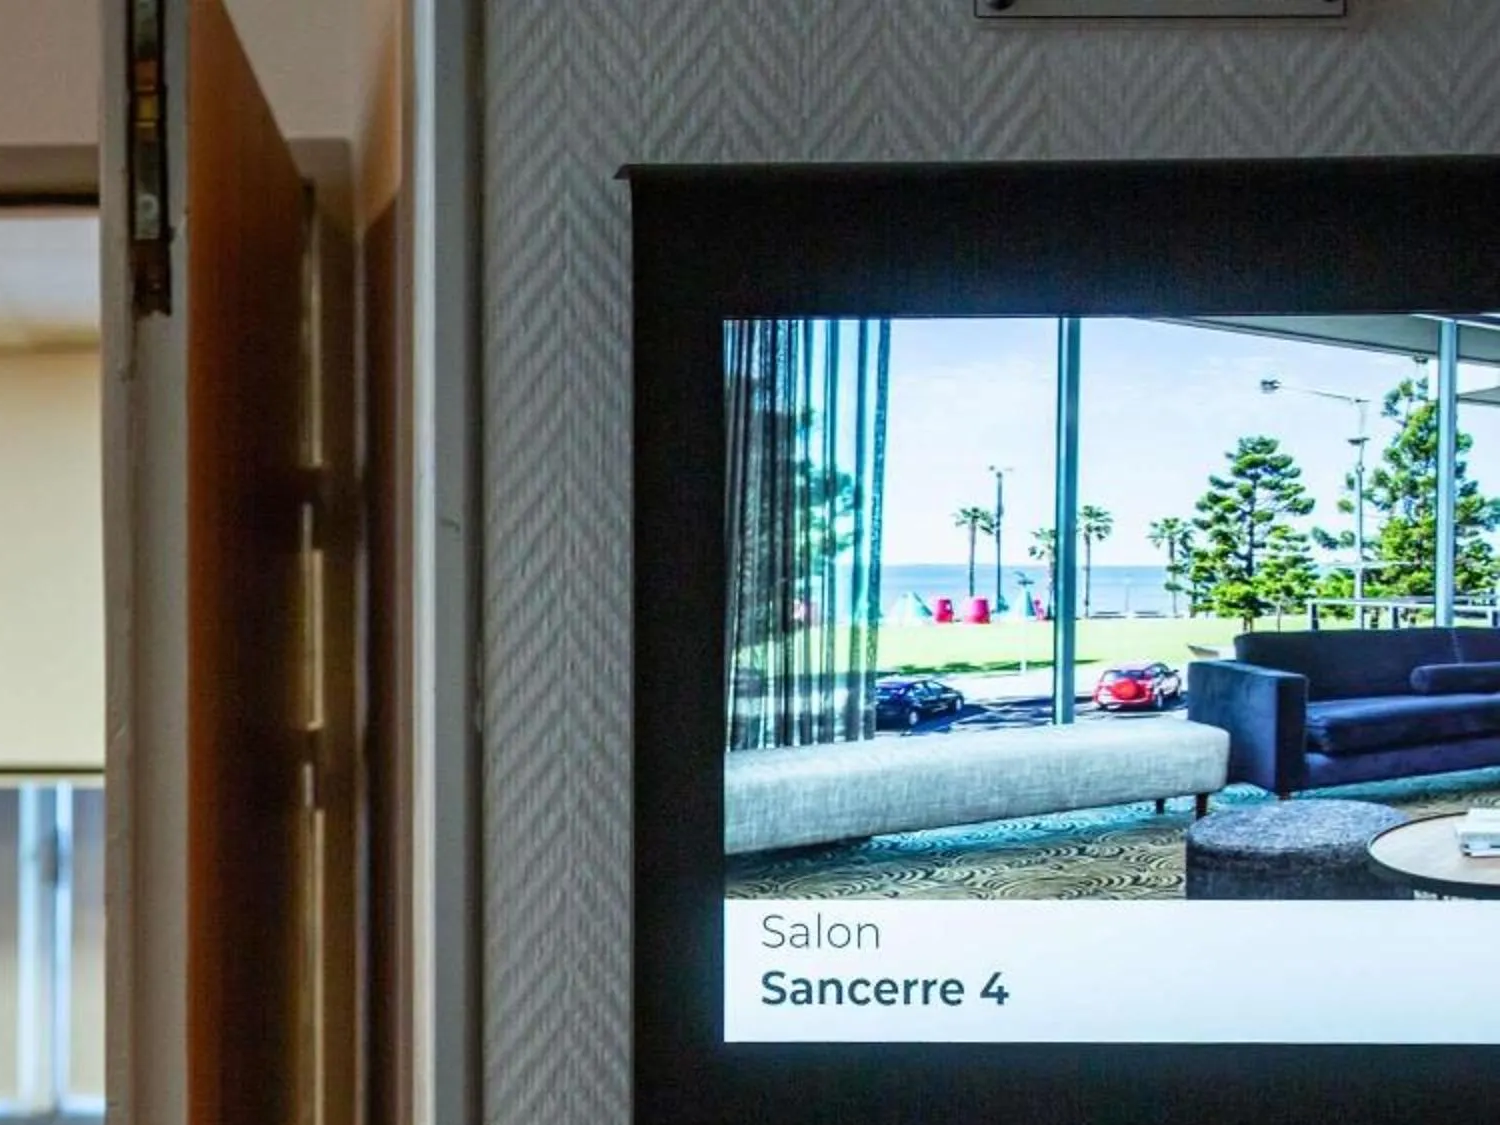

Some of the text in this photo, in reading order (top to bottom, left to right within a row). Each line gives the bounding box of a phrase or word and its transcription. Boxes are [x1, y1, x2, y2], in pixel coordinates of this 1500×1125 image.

[761, 912, 880, 949] Salon
[760, 970, 1010, 1006] Sancerre 4
